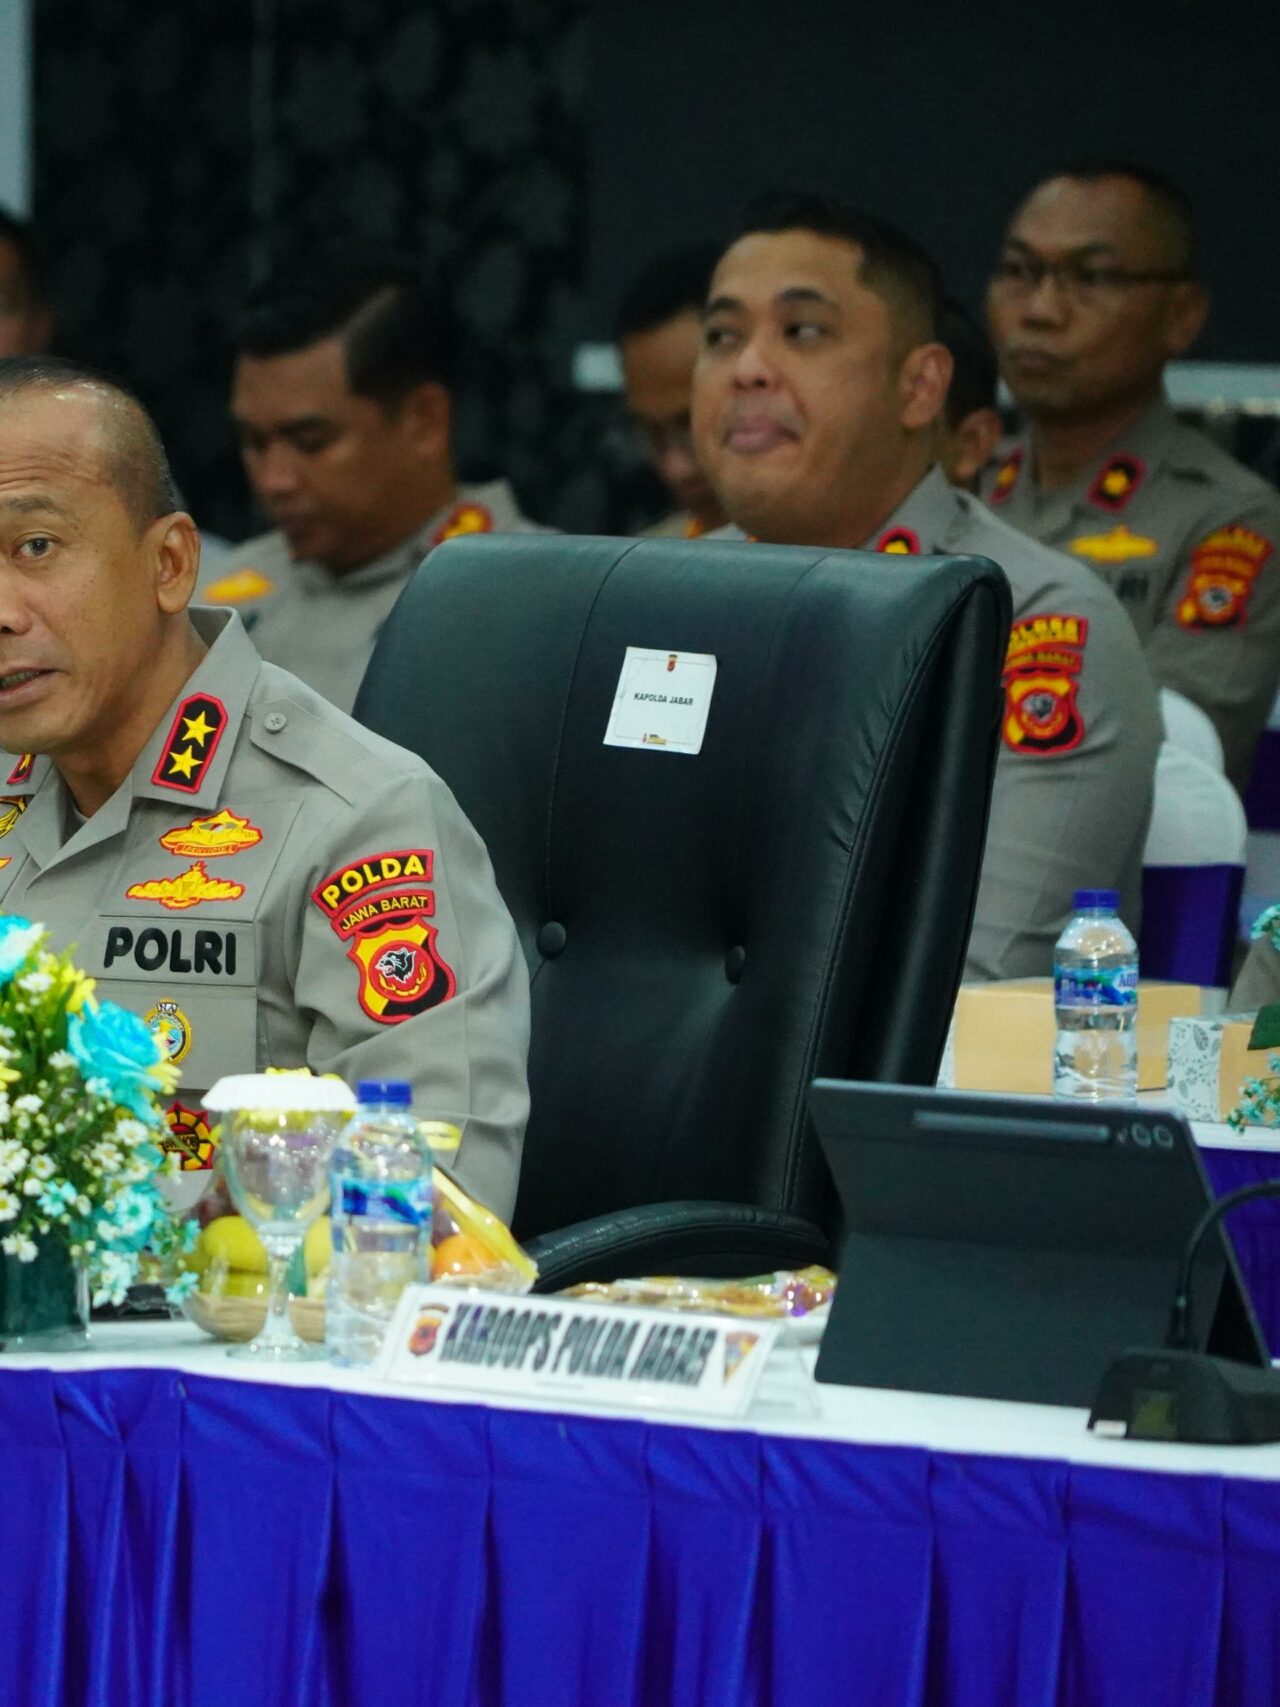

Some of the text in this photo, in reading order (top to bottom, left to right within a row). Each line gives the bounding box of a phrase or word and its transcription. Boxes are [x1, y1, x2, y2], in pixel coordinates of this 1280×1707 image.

[634, 692, 694, 706] KAPOLDA JABAR
[321, 854, 425, 909] POLDA
[342, 896, 428, 930] JAWA BARAT
[103, 926, 237, 976] POLRI
